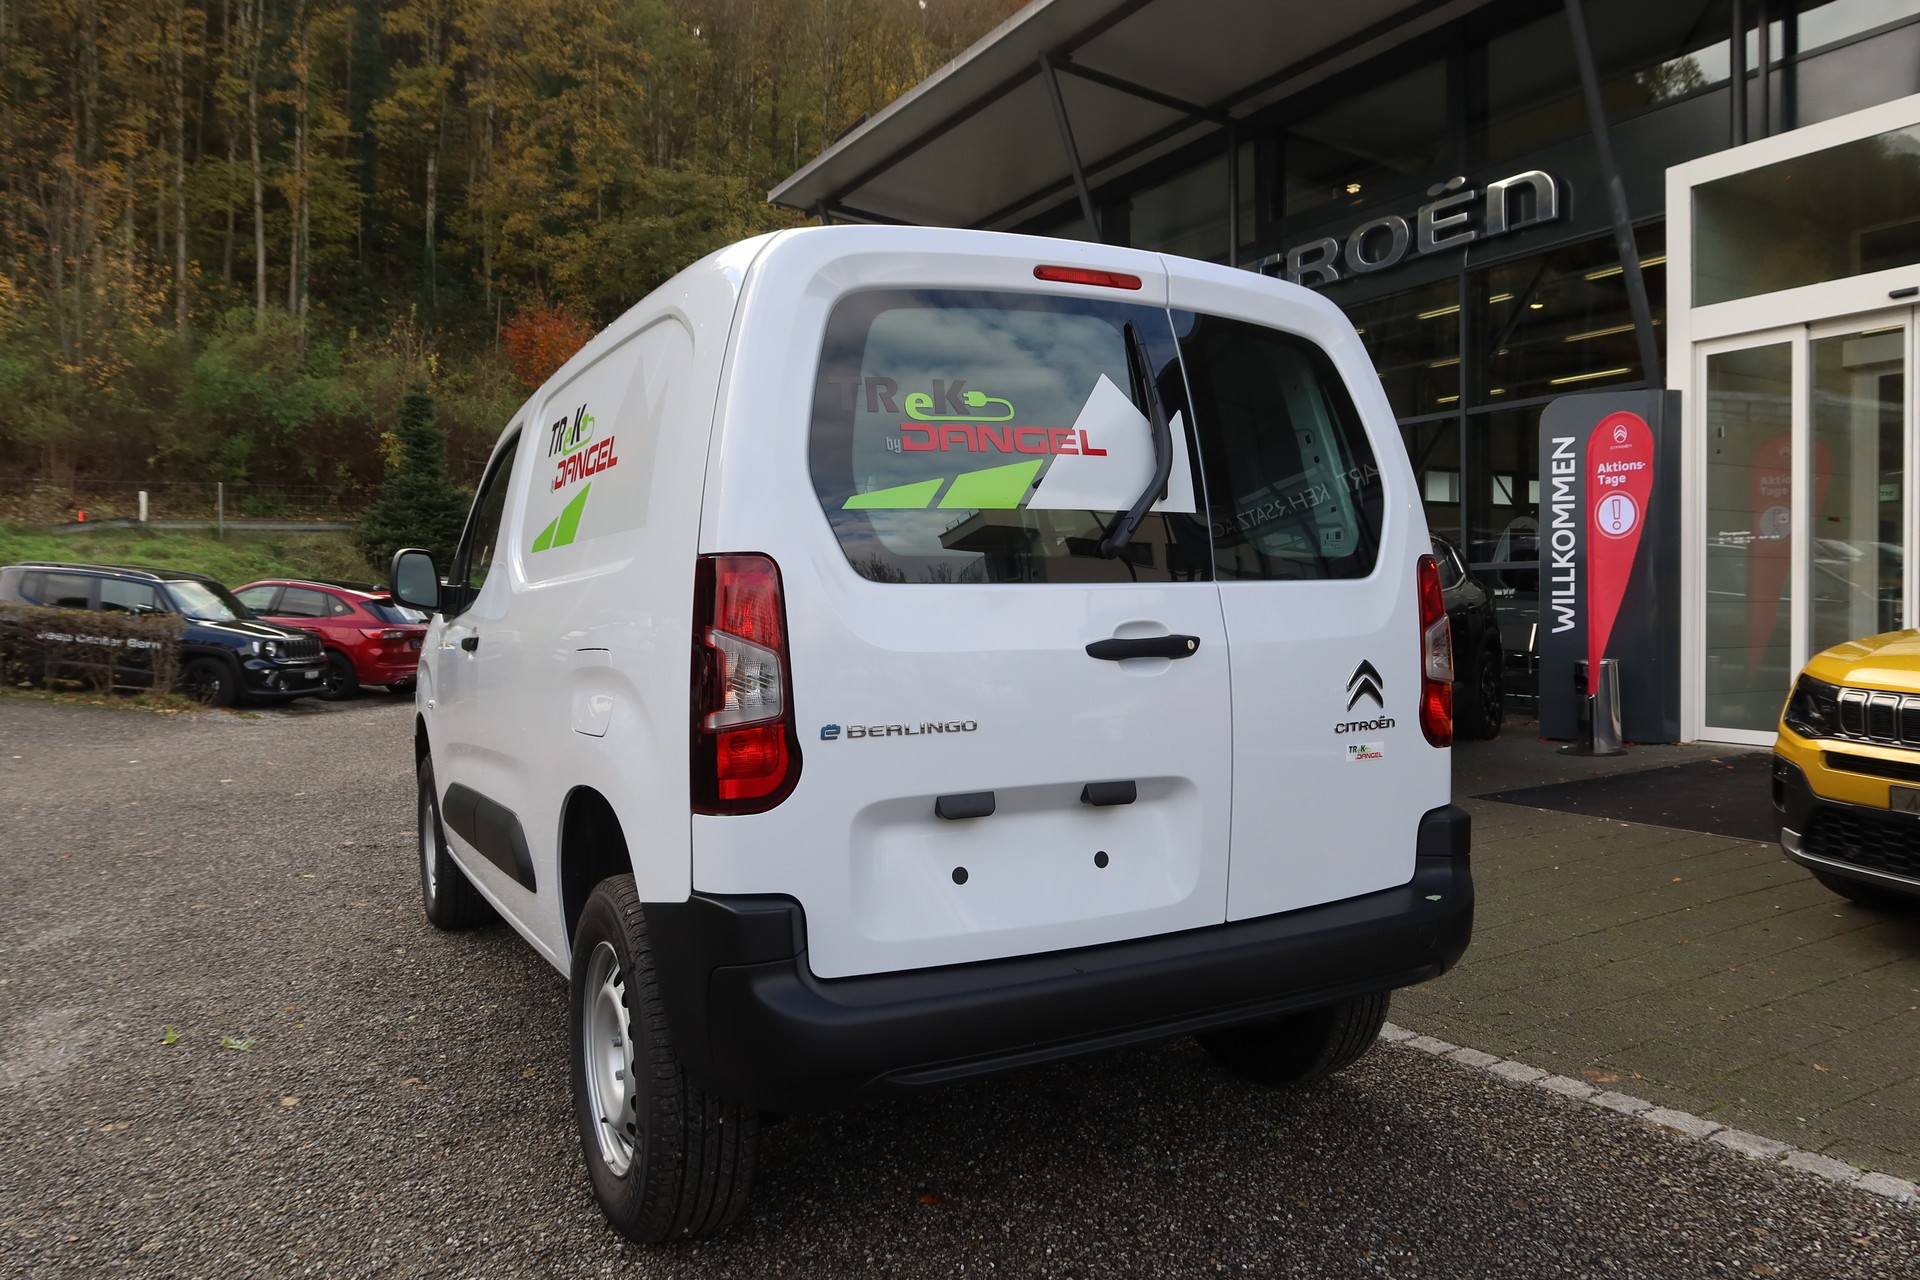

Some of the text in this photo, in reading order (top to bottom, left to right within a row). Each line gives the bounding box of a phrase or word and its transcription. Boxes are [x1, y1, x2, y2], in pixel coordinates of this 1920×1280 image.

[885, 423, 1107, 457] by DANGEL
[554, 435, 618, 490] DANGEL
[1597, 461, 1646, 474] Aktions-
[1597, 474, 1627, 487] Tage
[1551, 436, 1576, 634] WILLKOMMEN
[846, 719, 978, 739] BERLINGO
[1334, 715, 1396, 734] CITROËN
